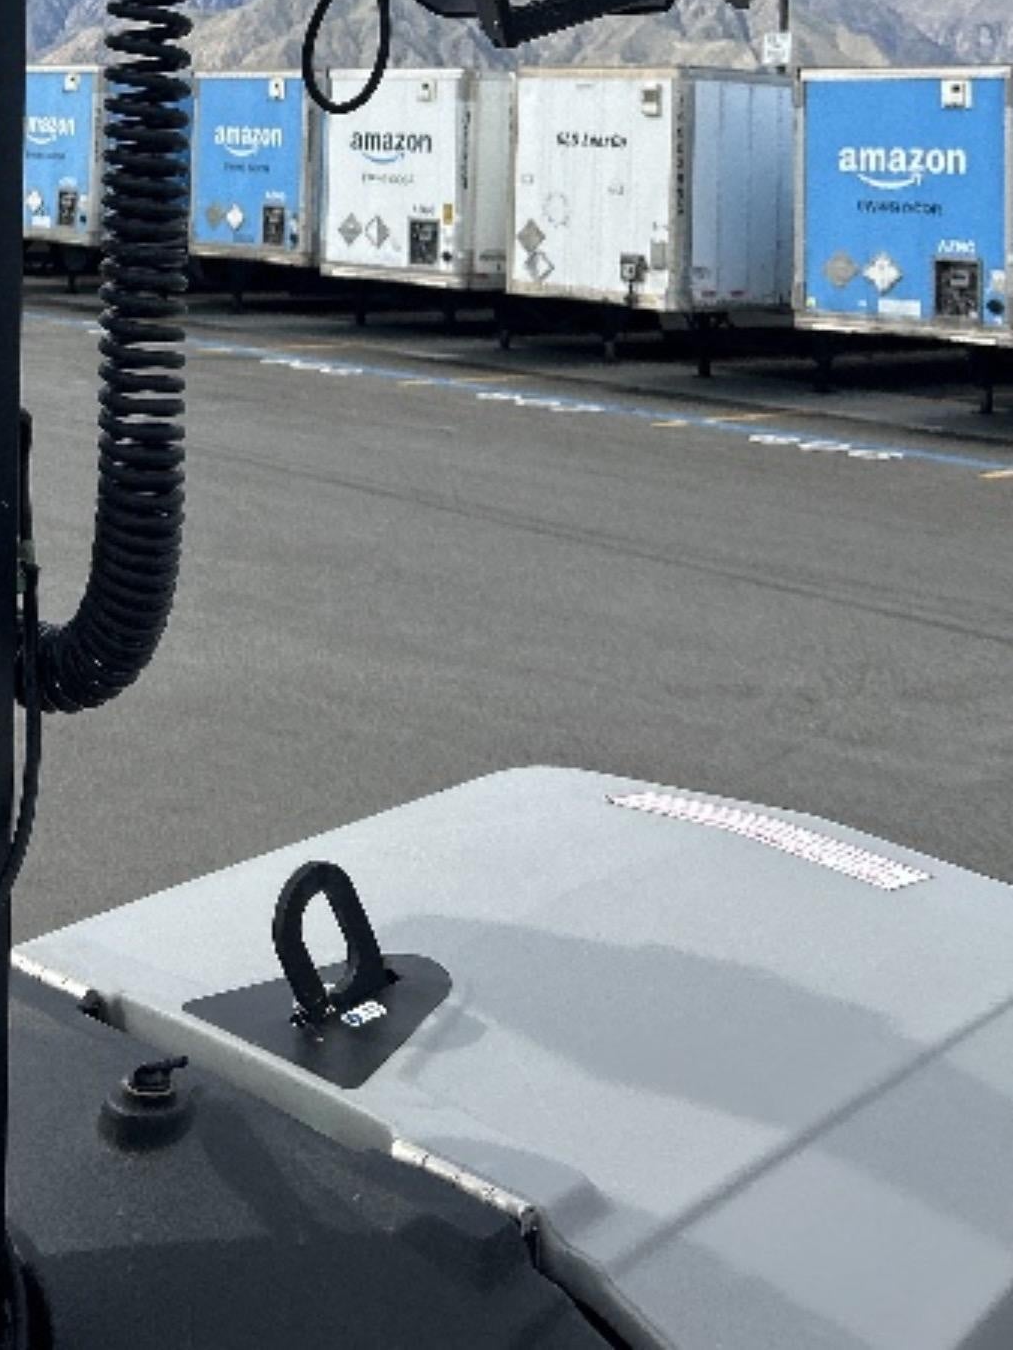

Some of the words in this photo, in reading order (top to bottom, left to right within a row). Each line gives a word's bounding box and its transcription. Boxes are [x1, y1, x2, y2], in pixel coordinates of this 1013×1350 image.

[27, 115, 76, 138] mazon
[213, 125, 283, 148] amazon
[349, 130, 433, 154] amazon
[838, 145, 967, 176] amazon
